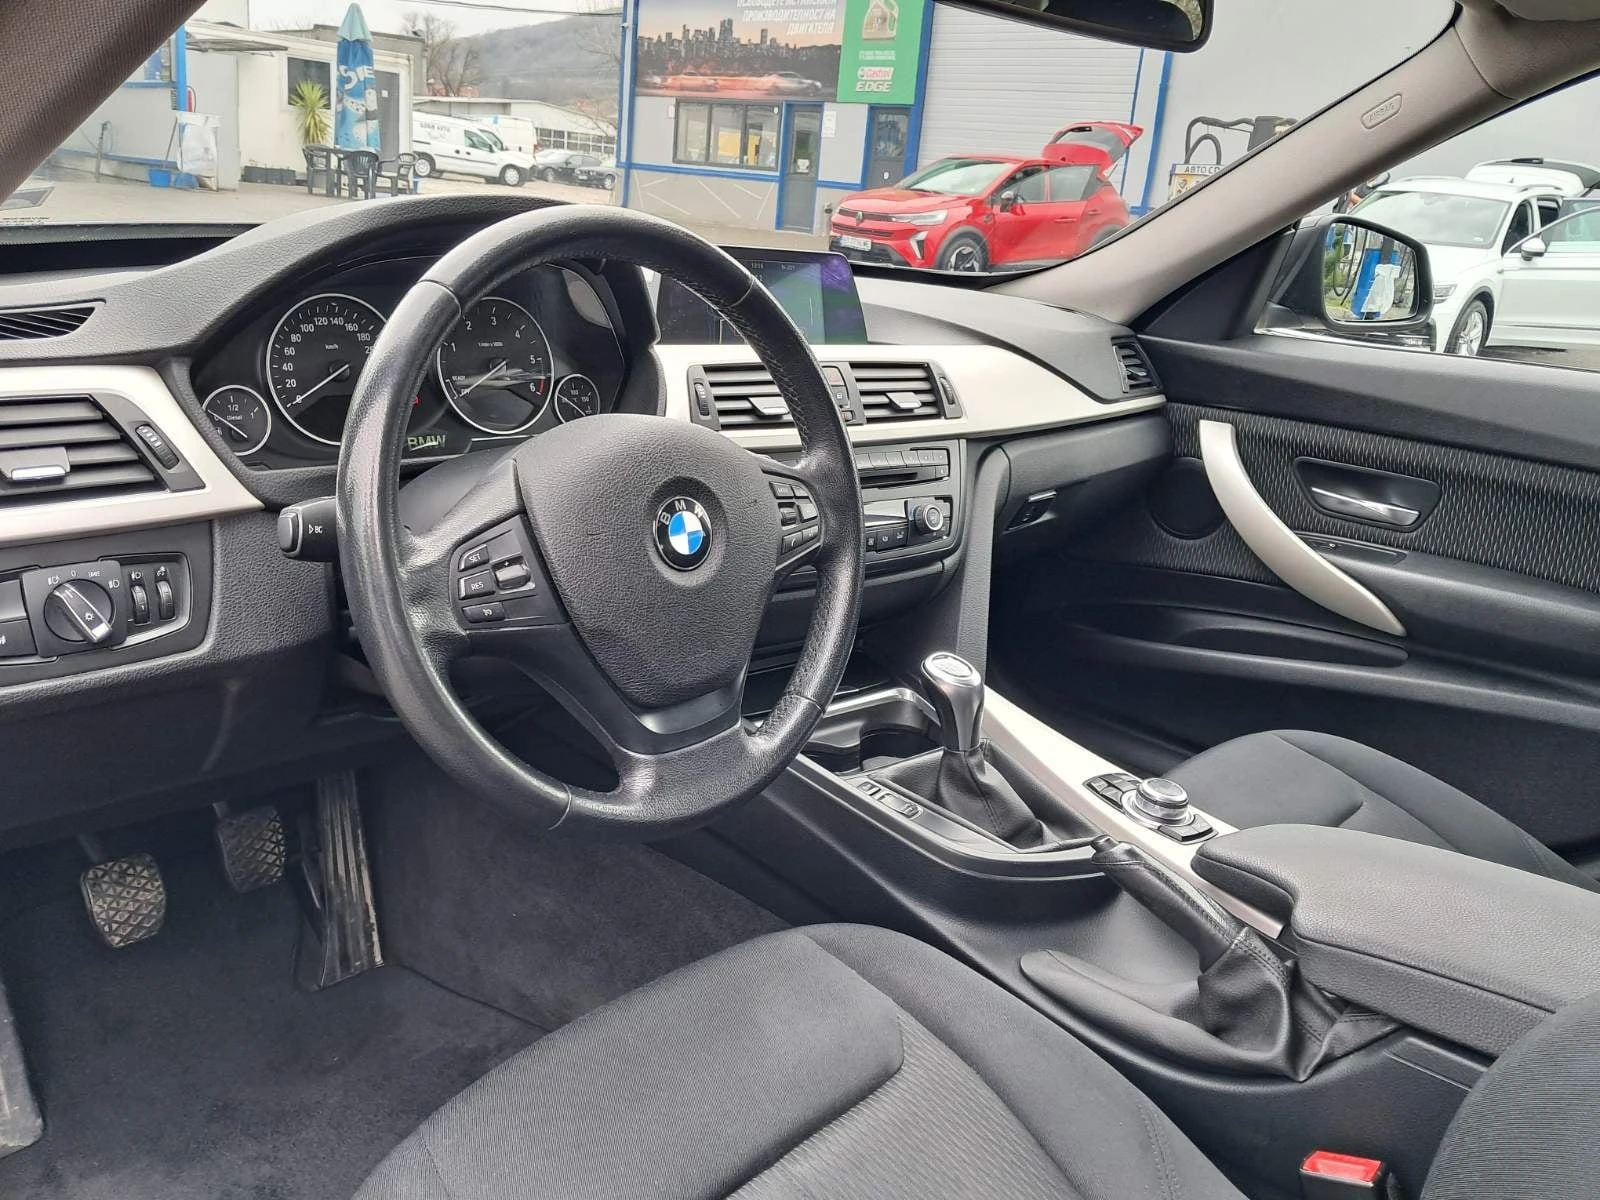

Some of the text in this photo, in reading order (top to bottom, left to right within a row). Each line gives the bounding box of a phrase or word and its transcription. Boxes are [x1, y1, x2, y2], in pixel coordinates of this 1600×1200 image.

[856, 81, 893, 92] EDGE
[314, 317, 328, 326] 120
[330, 317, 344, 326] 140
[466, 321, 472, 330] 2
[491, 316, 497, 326] 3
[300, 323, 315, 333] 100
[345, 323, 359, 332] 160
[290, 333, 302, 343] 80
[357, 333, 371, 342] 180
[515, 330, 521, 338] 4
[284, 347, 296, 356] 60
[451, 342, 456, 352] 1
[530, 355, 536, 364] 5
[282, 363, 294, 372] 40
[285, 379, 297, 388] 20
[529, 382, 536, 392] 6
[228, 404, 239, 412] 1/2
[408, 434, 446, 449] BMW
[660, 499, 705, 526] BMW
[314, 525, 323, 534] BC
[468, 553, 481, 563] SET
[471, 581, 484, 591] RES
